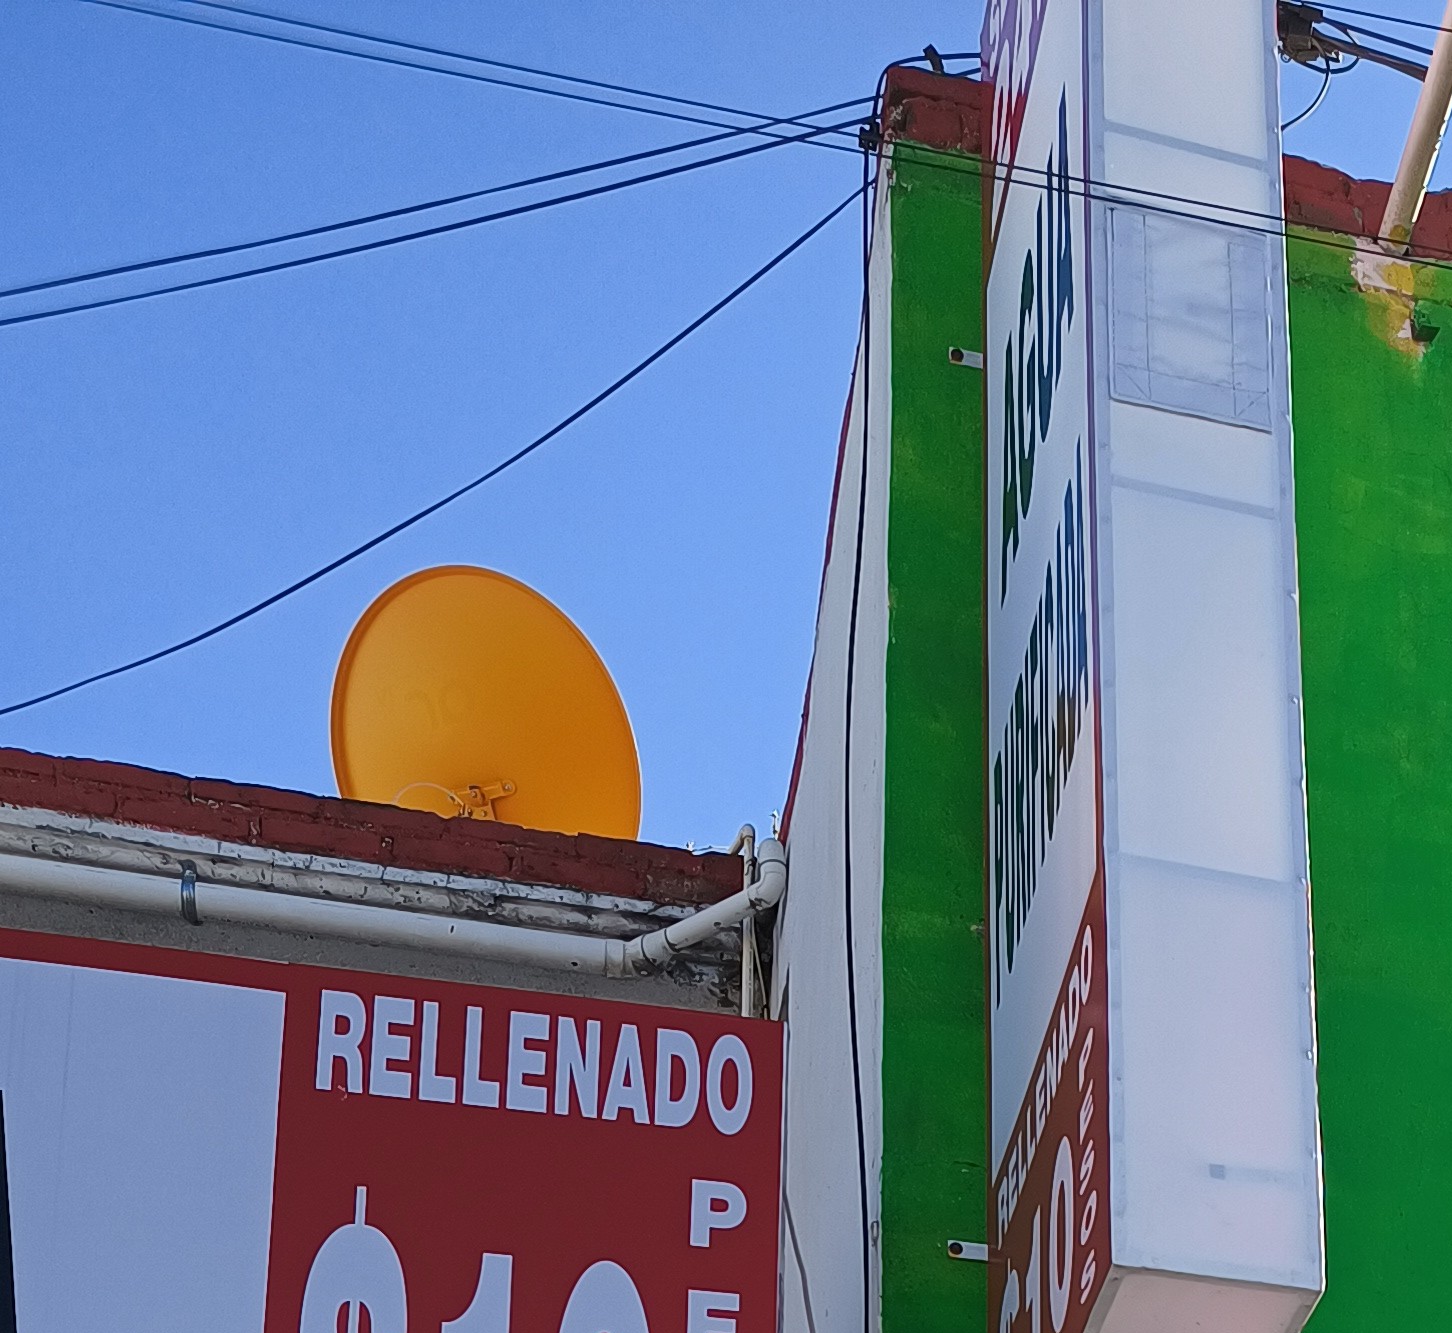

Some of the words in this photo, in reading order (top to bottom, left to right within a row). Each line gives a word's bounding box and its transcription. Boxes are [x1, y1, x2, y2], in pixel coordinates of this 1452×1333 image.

[1001, 81, 1075, 609] AGUA
[993, 433, 1089, 1010] PURIFICADA
[315, 988, 754, 1136] RELLENADO
[998, 924, 1092, 1250] RELLENADO
[1079, 1027, 1097, 1304] PESOS
